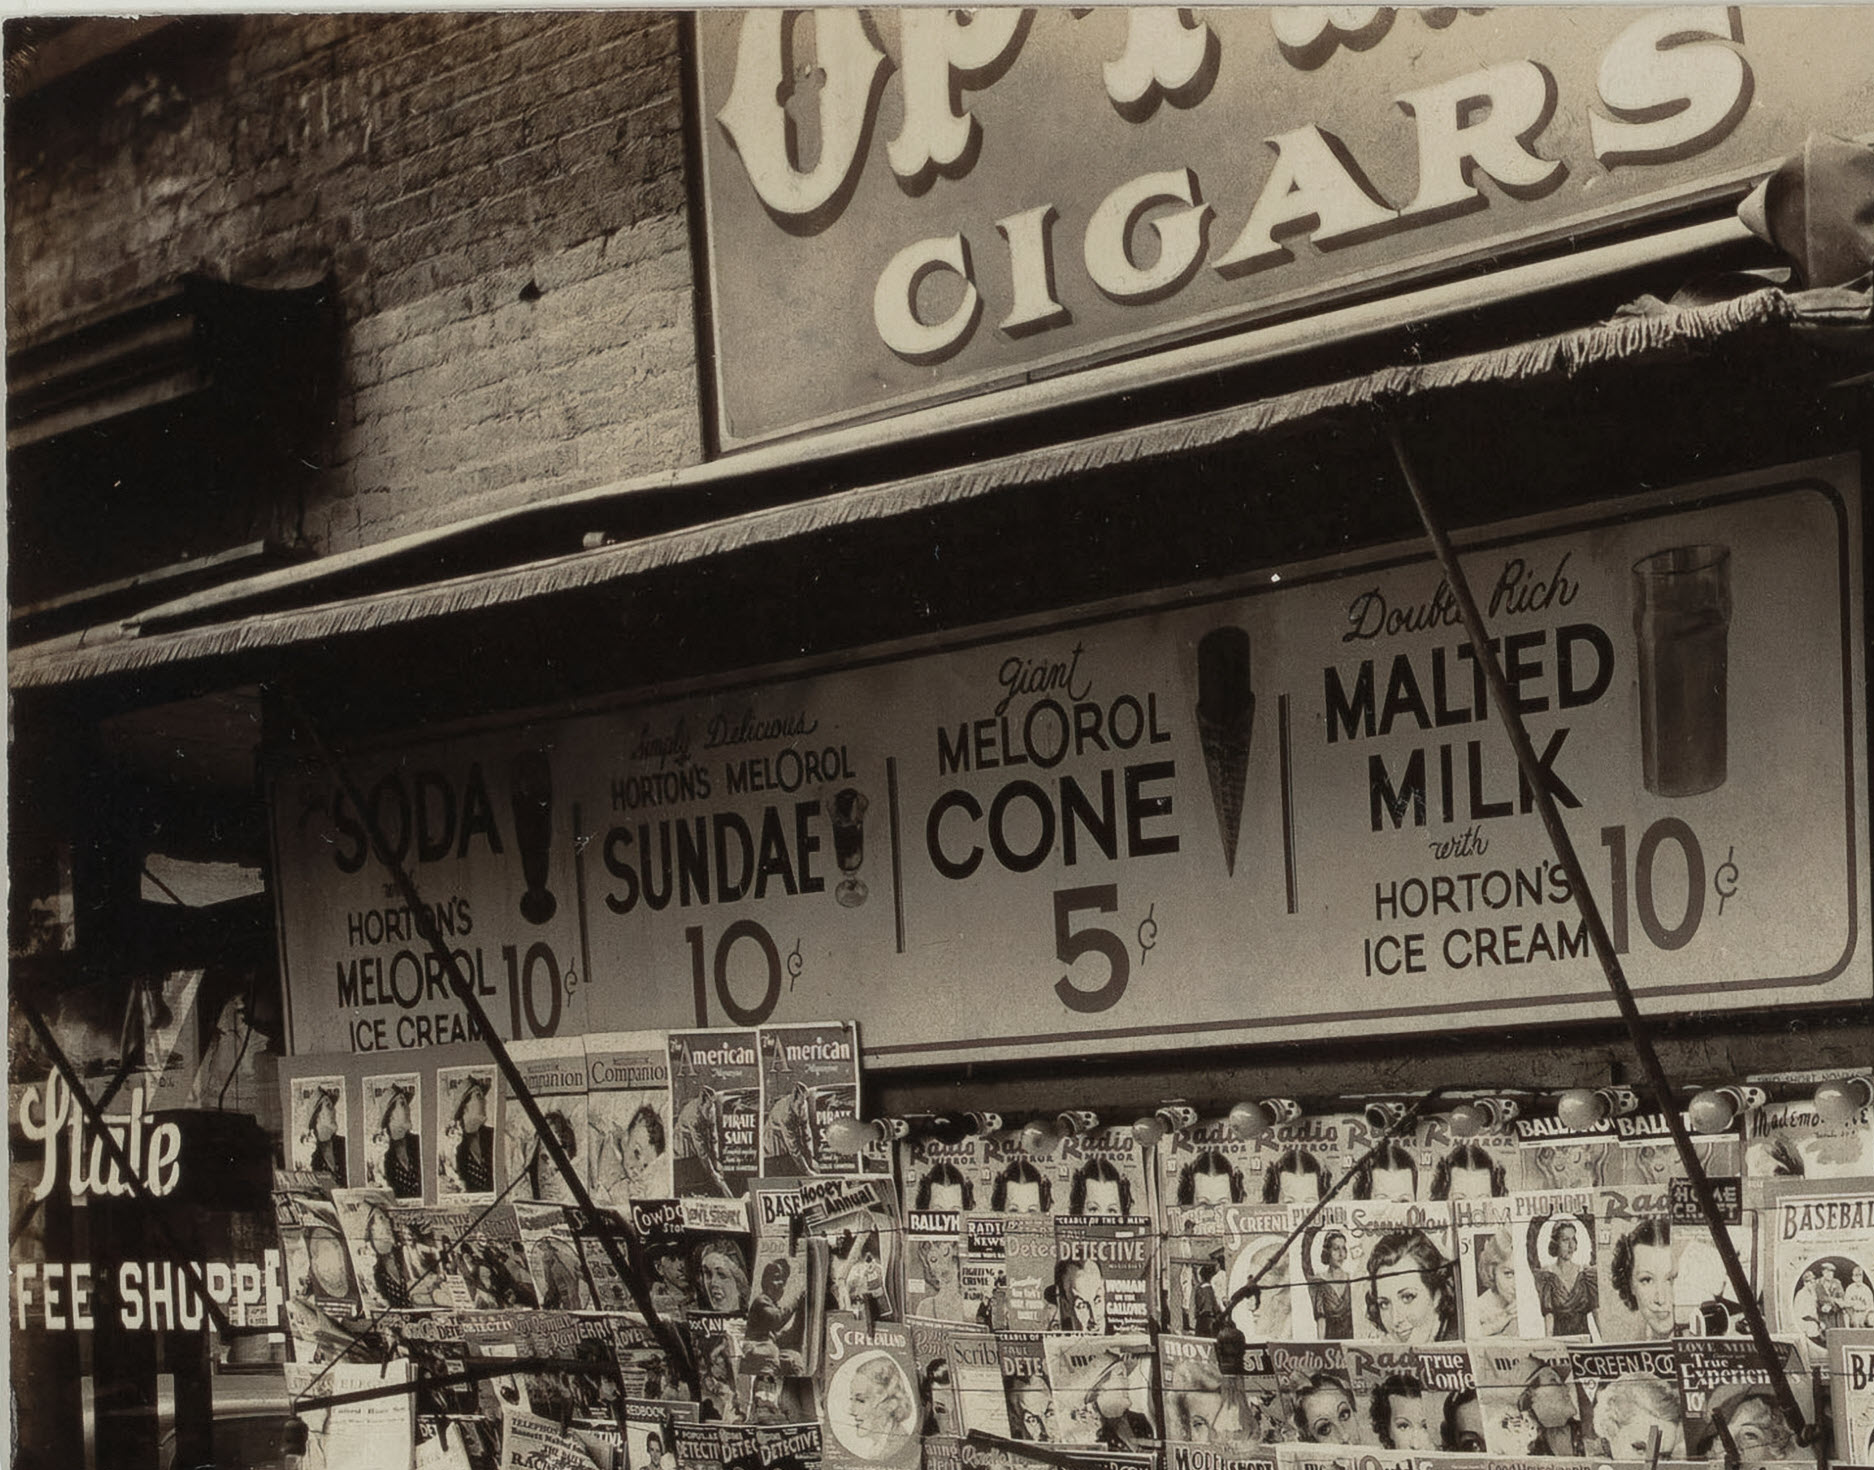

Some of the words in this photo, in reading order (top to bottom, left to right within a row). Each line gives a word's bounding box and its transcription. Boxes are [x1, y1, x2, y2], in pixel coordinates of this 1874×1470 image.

[871, 5, 1759, 364] CIGARS
[1486, 550, 1580, 619] Rich
[1322, 622, 1615, 745] MALTED
[936, 691, 1172, 777] MELOROL
[611, 765, 711, 813] HORTON'S
[726, 745, 856, 796] MELOROL
[1367, 726, 1586, 833] MILK
[331, 762, 504, 875] SODA
[925, 760, 1181, 881] CONE
[1428, 828, 1490, 862] with
[603, 800, 825, 916] SUNDAE
[1373, 862, 1574, 922] HORTON'S
[335, 947, 497, 1011] MELOROL
[685, 919, 804, 1029] 10¢
[1051, 882, 1159, 1015] 5¢
[1362, 932, 1428, 980] ICE
[1441, 918, 1592, 971] CREAM
[349, 1021, 388, 1054] ICE
[720, 1112, 757, 1132] PIRATE
[723, 1130, 753, 1147] SAINT
[1059, 1241, 1145, 1262] DETECTIVE
[1572, 1353, 1640, 1379] SCREEN
